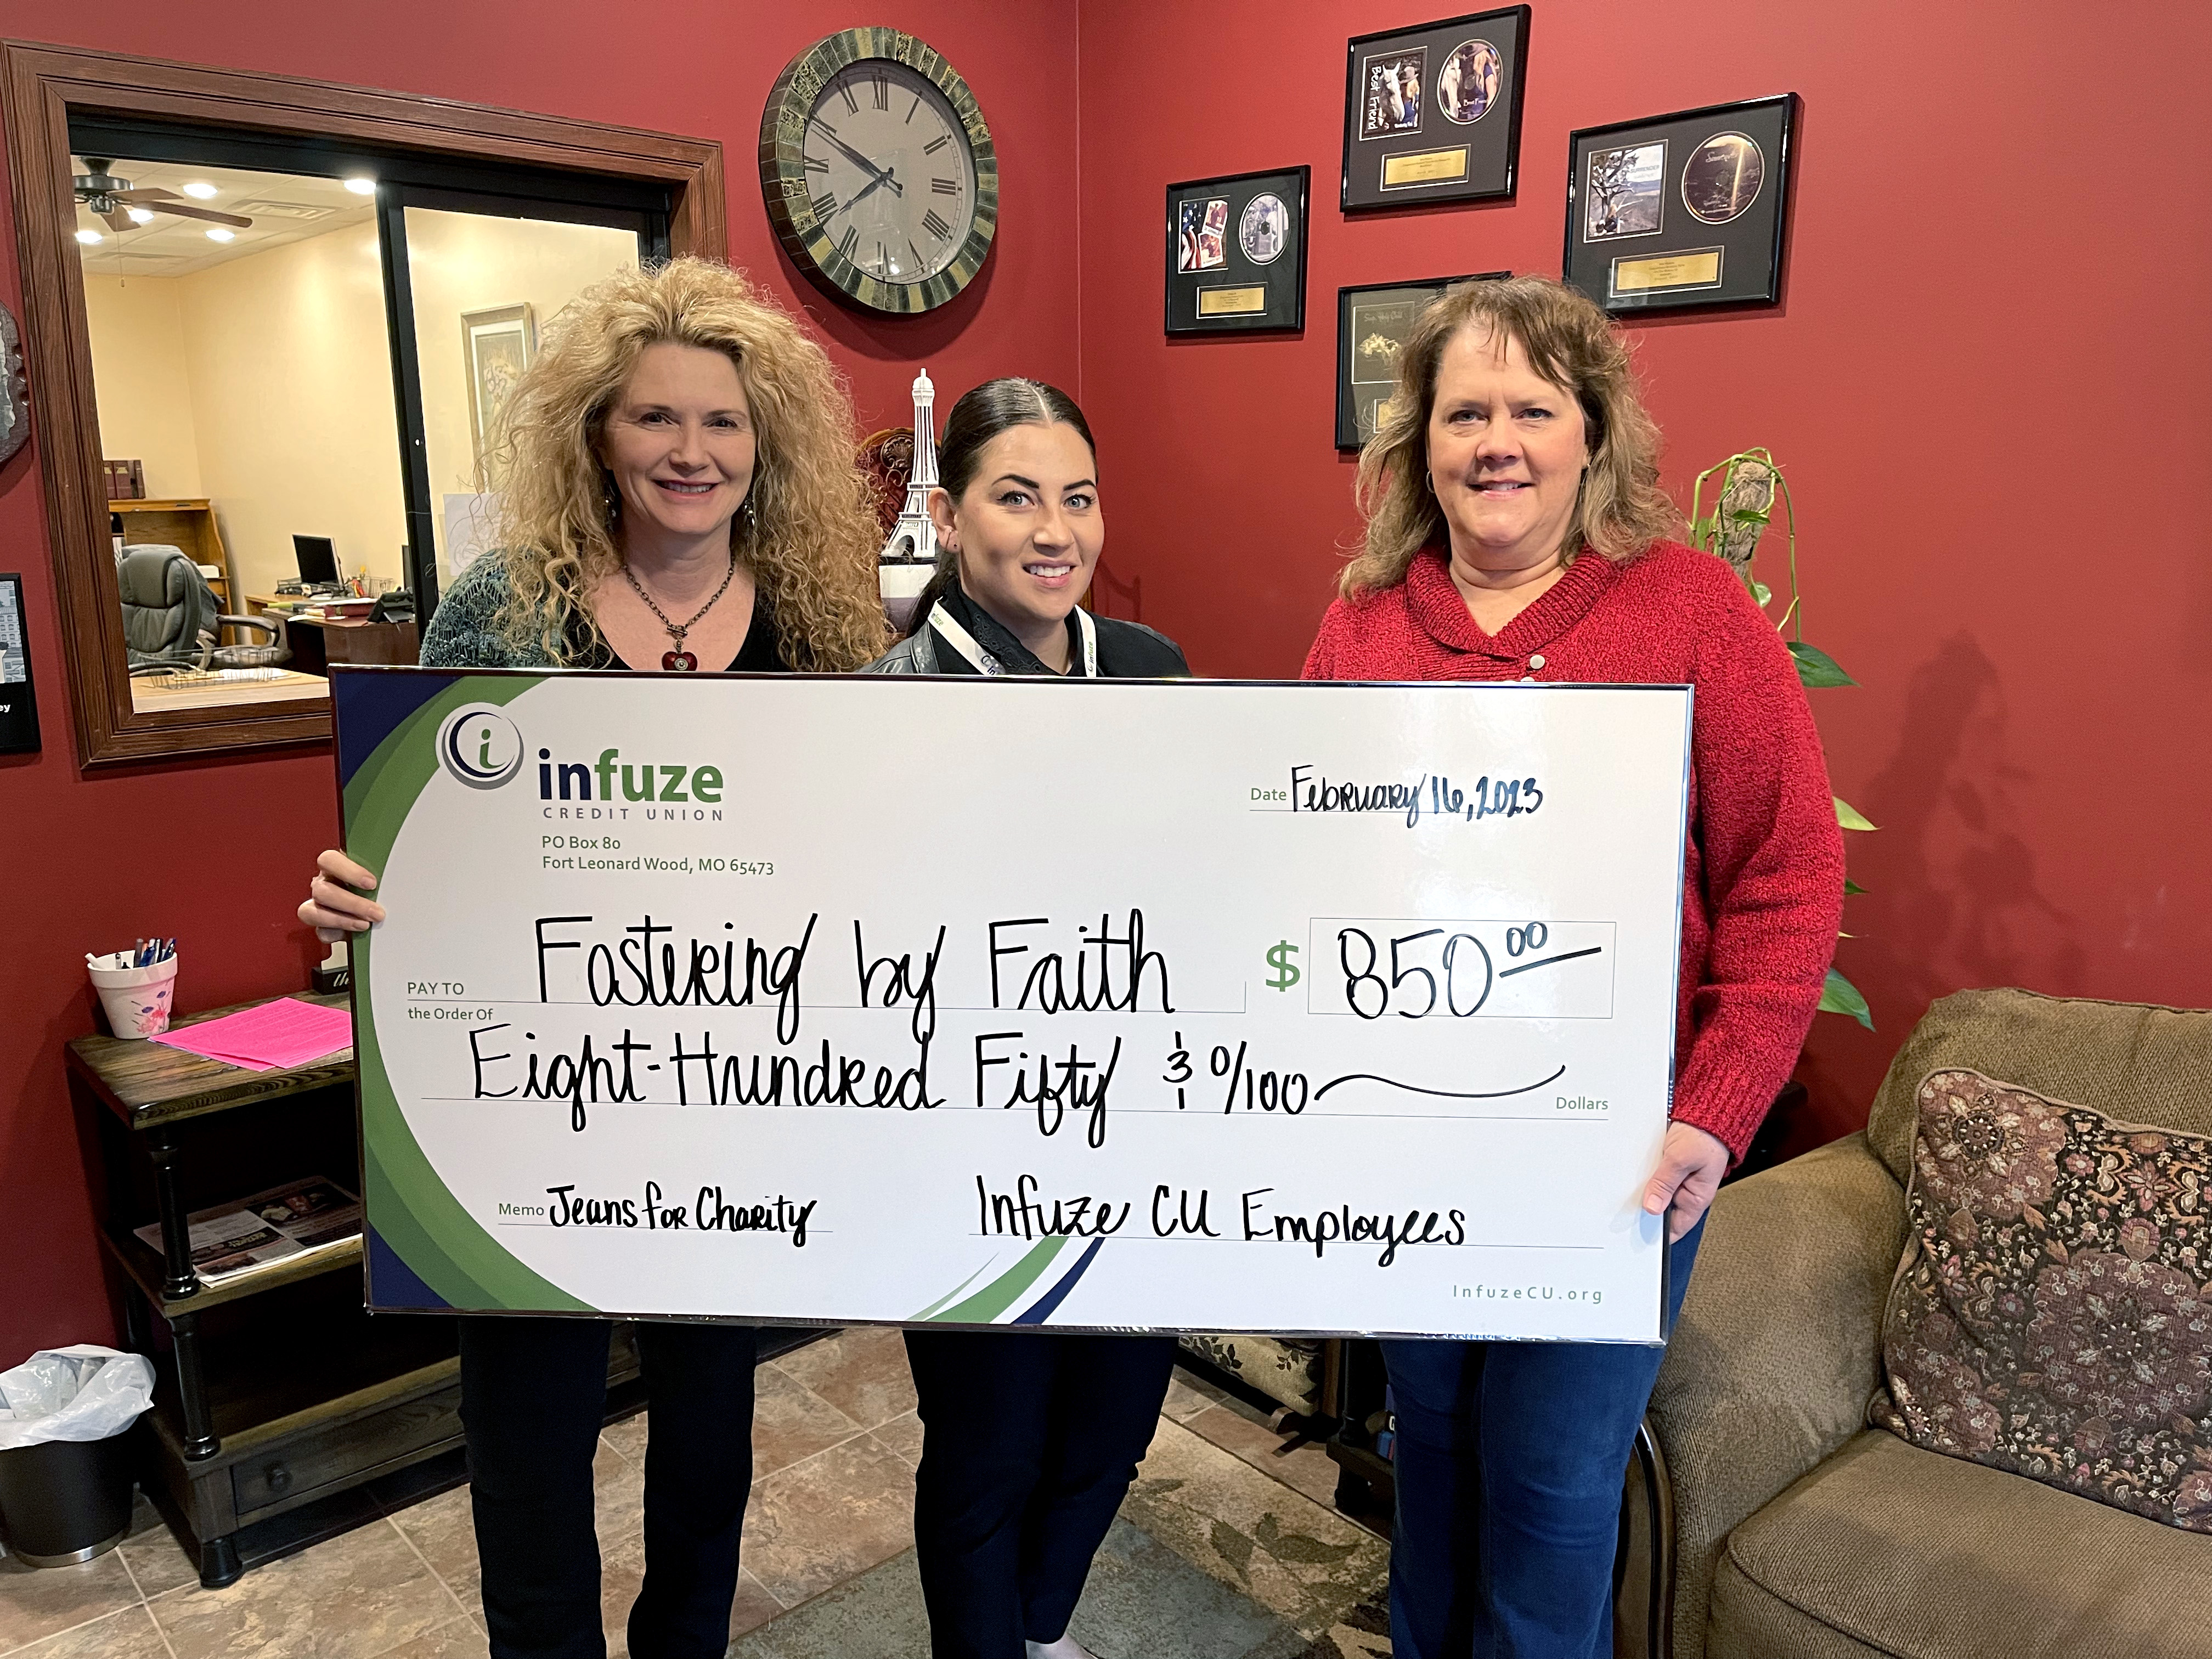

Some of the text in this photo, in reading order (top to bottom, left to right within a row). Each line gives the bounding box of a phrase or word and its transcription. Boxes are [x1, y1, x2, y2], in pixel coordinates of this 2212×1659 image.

[836, 80, 859, 117] XI
[872, 74, 889, 112] XII
[1368, 66, 1381, 130] Best Friend
[923, 135, 947, 155] II
[932, 178, 956, 195] III
[539, 748, 723, 803] infuze
[1251, 788, 1286, 801] Date
[543, 808, 722, 821] CREDIT UNION
[543, 836, 620, 849] PO Box 80
[543, 856, 774, 876] Fort Leonard Wood, MO 65473
[854, 920, 946, 1043] by
[989, 909, 1175, 1014] Faith
[1266, 940, 1300, 992] $
[407, 981, 464, 995] PAY TO
[408, 1007, 494, 1020] the Order Of
[975, 1031, 1121, 1148] Fifty
[1556, 1096, 1609, 1110] Dollars
[499, 1203, 545, 1216] Memo
[546, 1184, 638, 1228] Jeans
[696, 1186, 817, 1247] Charity
[976, 1175, 1465, 1267] Infuze CU Employees
[1453, 1284, 1602, 1305] InfuzeCU.org
